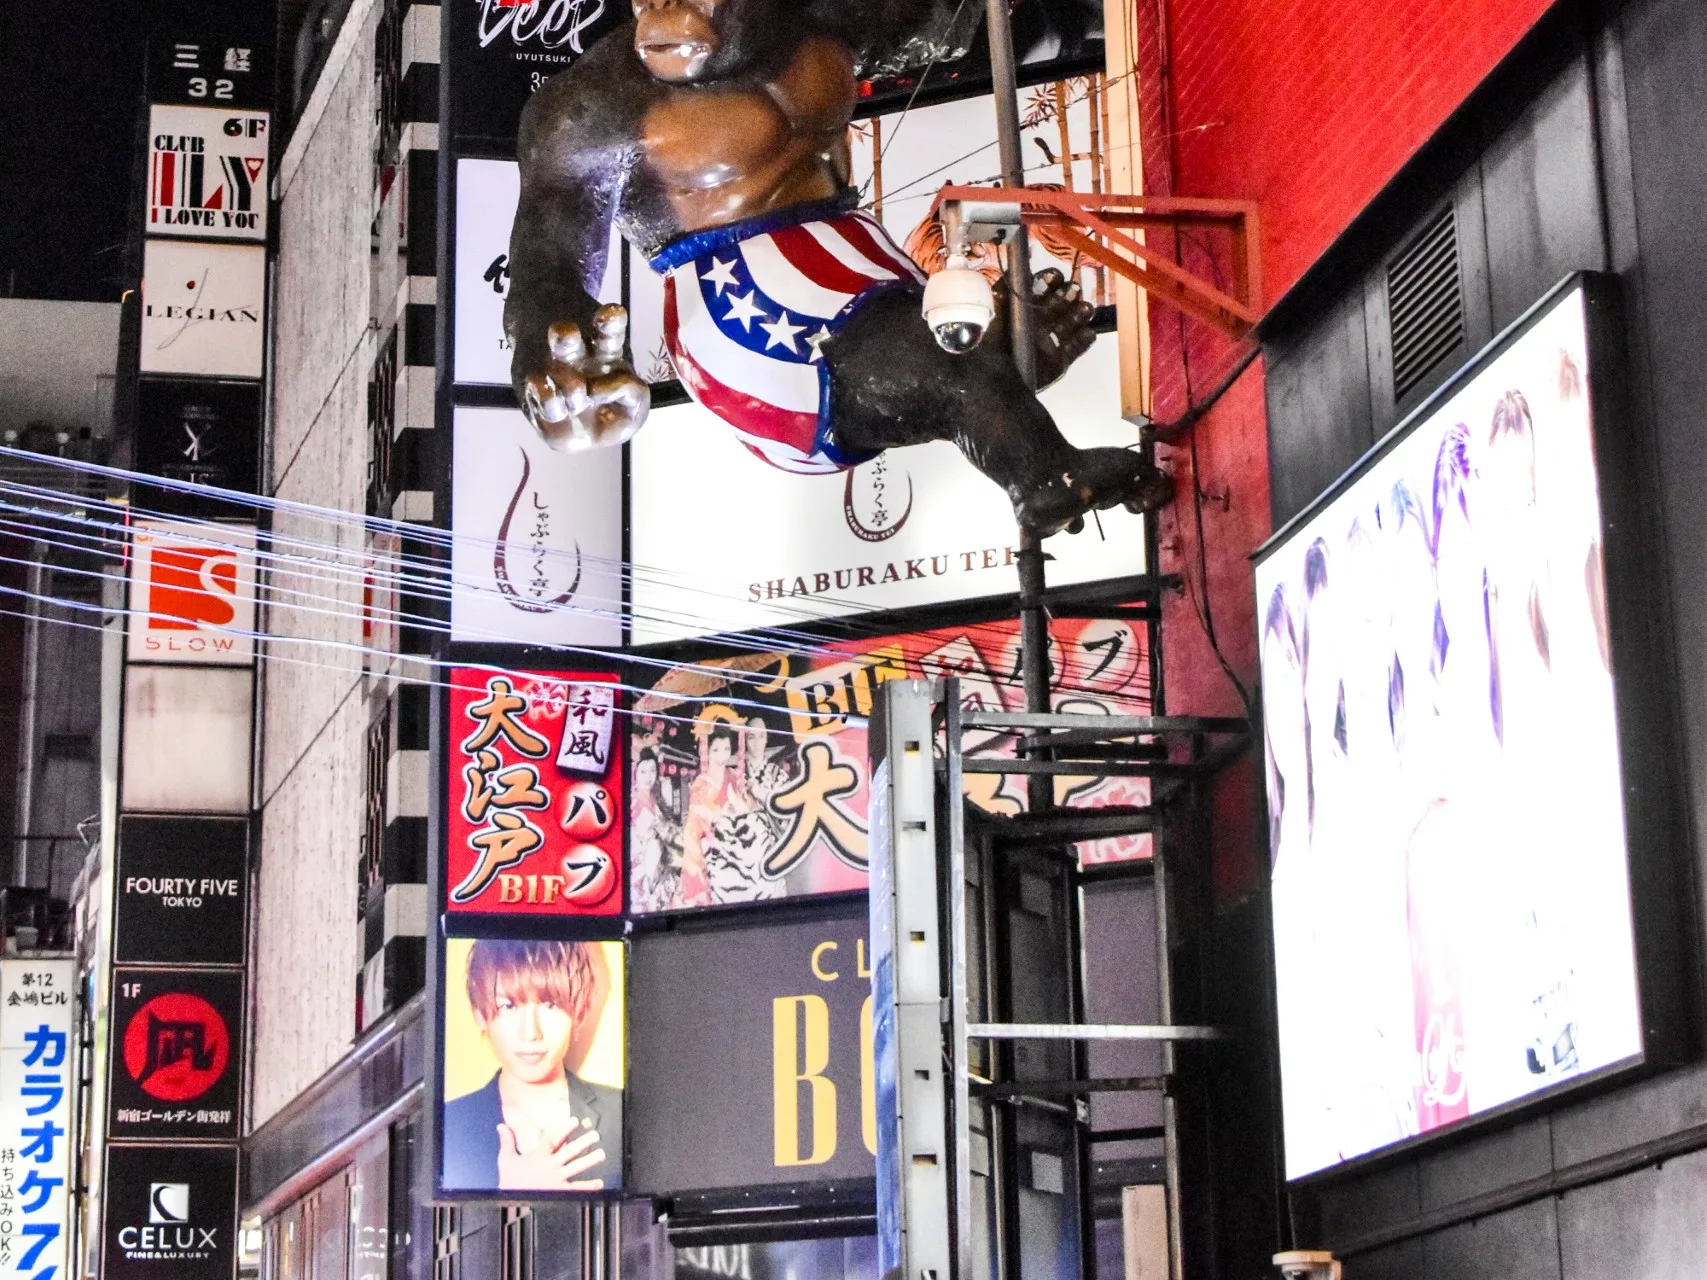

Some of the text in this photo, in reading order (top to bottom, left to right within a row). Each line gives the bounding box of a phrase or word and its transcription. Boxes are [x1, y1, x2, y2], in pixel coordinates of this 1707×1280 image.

[188, 77, 234, 100] 32
[222, 118, 266, 138] 6F
[154, 134, 205, 153] CLUB
[151, 207, 259, 230] I LOVE YOU
[146, 305, 259, 323] LEGIAN
[747, 554, 950, 603] SHABURAKU
[145, 636, 234, 652] SLOW
[455, 679, 549, 901] 大江戸
[125, 877, 238, 896] FOURTY FIVE
[499, 873, 565, 905] B1F
[162, 896, 202, 908] TOKYO
[121, 982, 142, 999] 1F
[118, 1226, 218, 1250] CELUX
